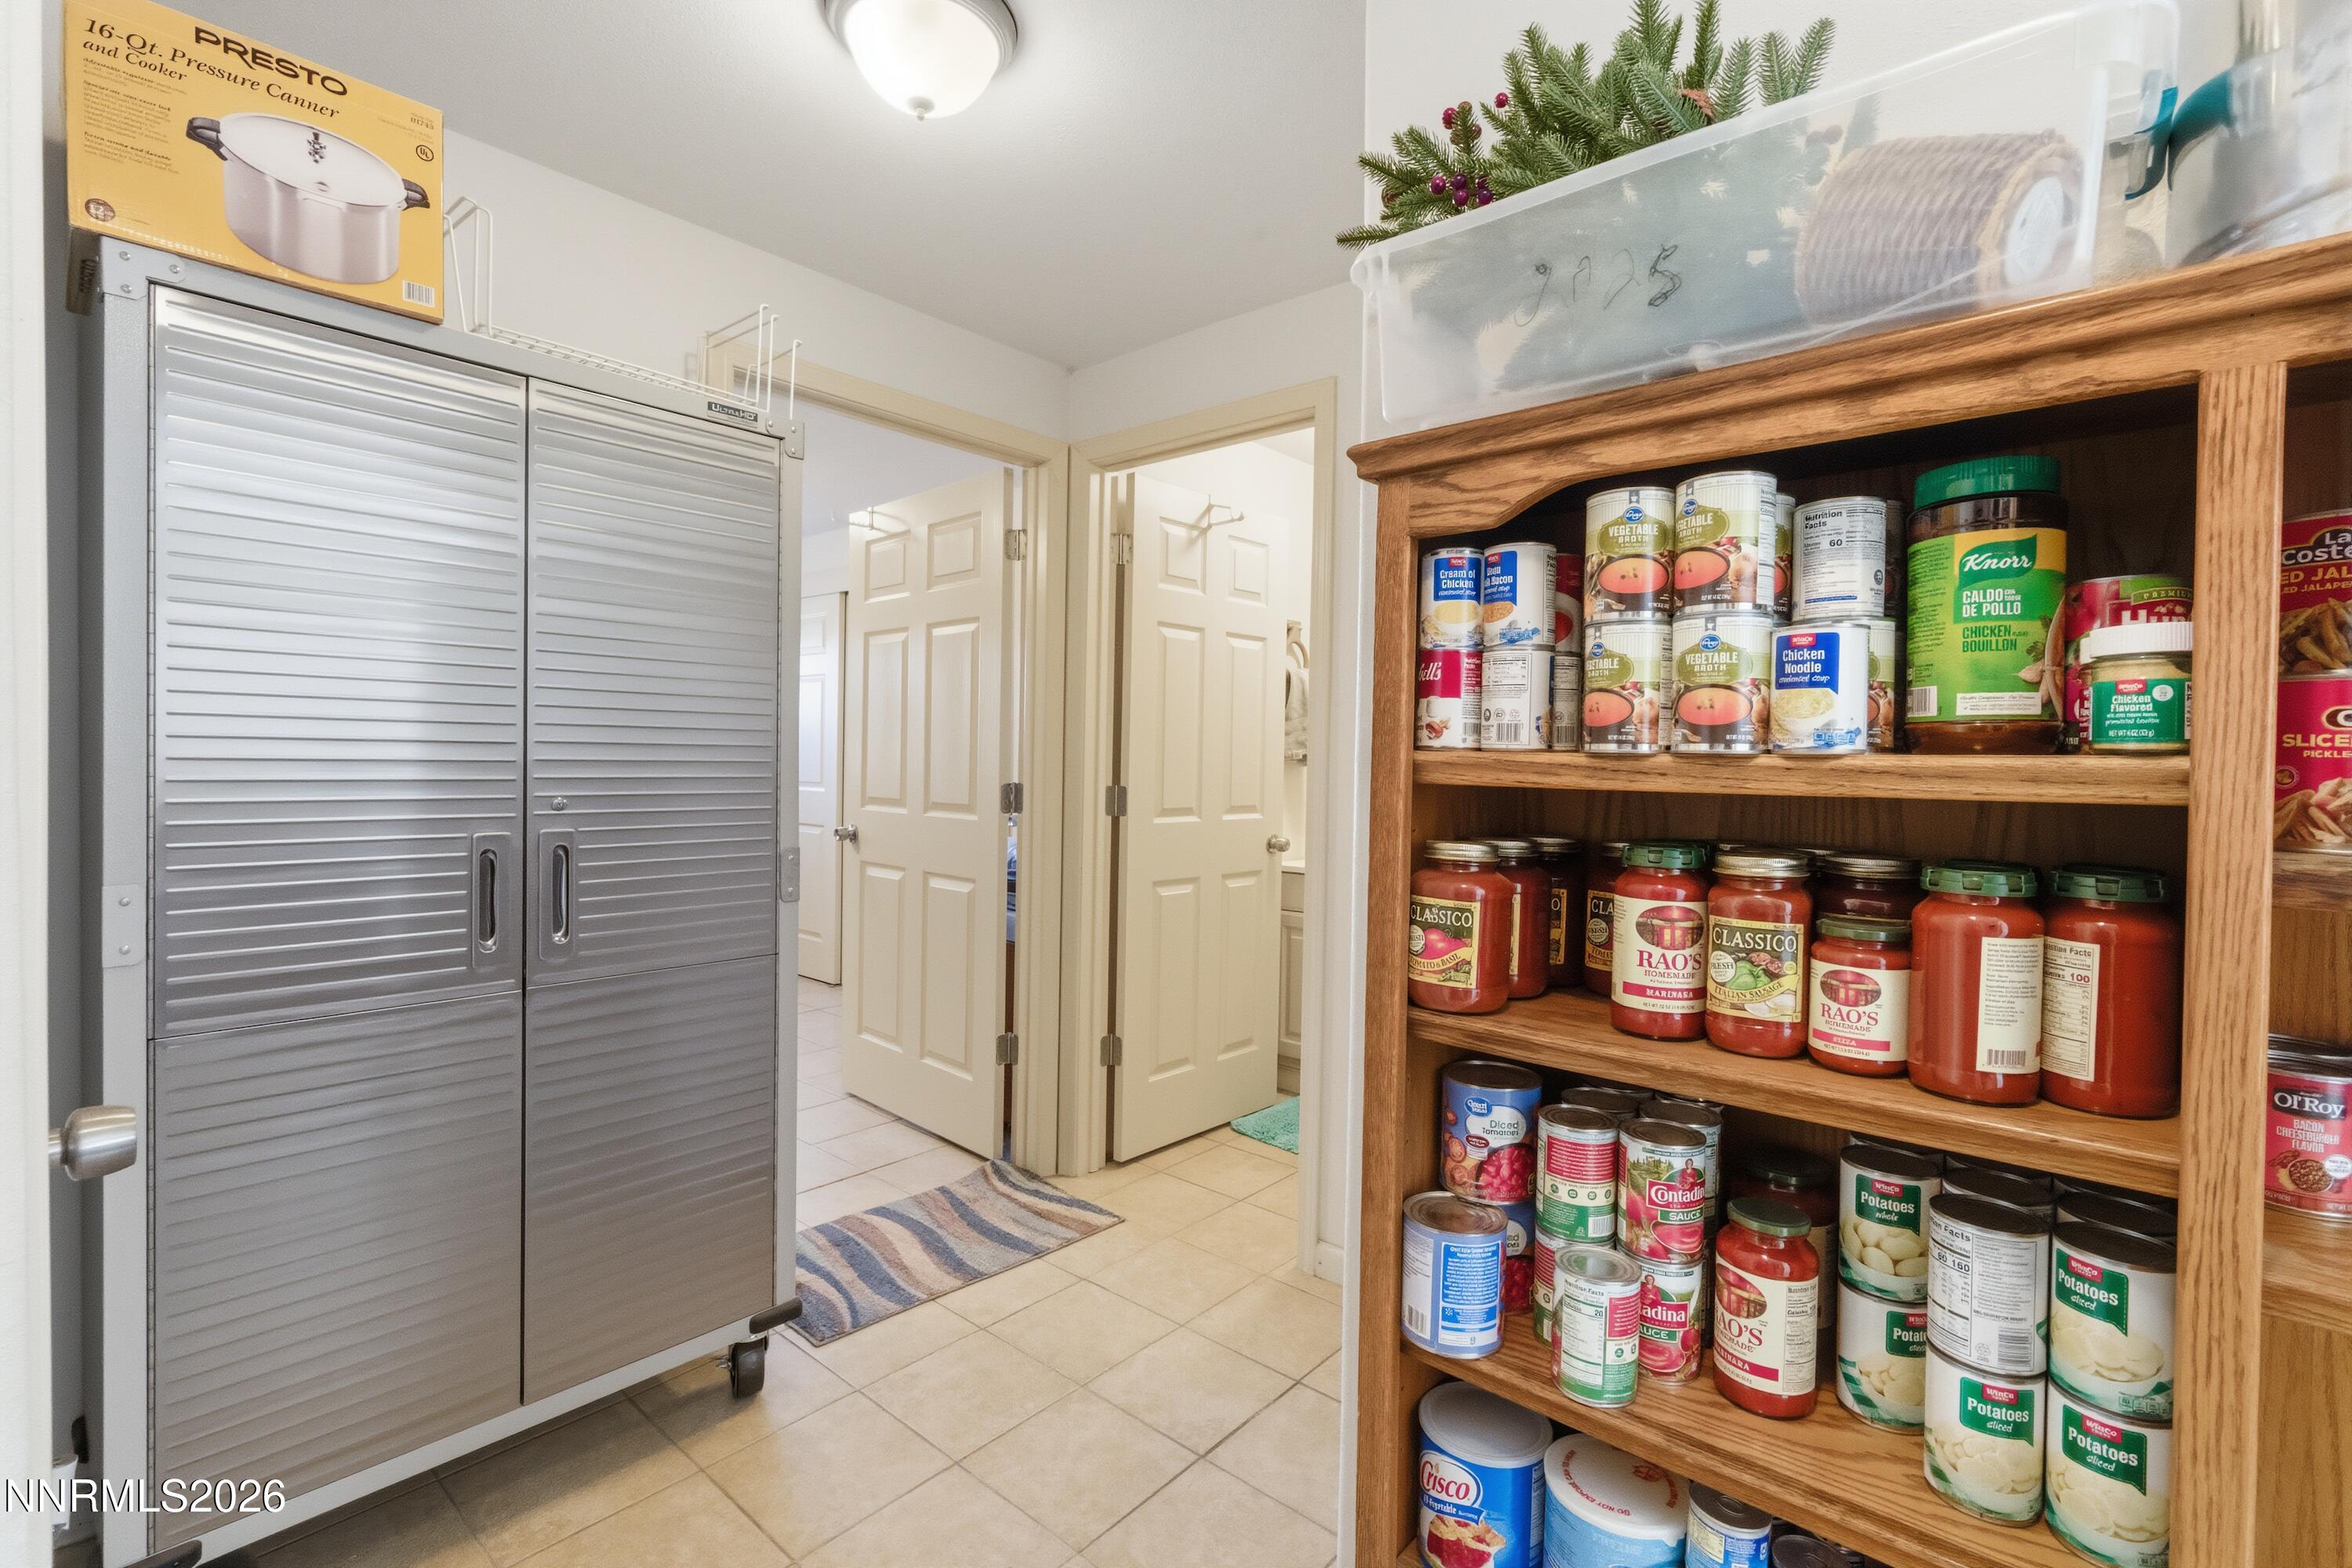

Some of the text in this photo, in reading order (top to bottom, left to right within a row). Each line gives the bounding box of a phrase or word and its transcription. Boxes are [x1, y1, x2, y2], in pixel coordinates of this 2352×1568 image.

[83, 41, 118, 58] and
[125, 53, 187, 80] Cooker
[195, 27, 347, 96] PRESTO
[83, 18, 163, 57] 16-Qt.
[169, 47, 260, 90] Pressure
[267, 83, 339, 118] Canner
[1805, 510, 1842, 522] Nutrition
[1609, 524, 1658, 537] VEGETABLE
[1805, 521, 1828, 529] Facts
[1829, 539, 1842, 547] 60
[2325, 532, 2352, 545] La
[1962, 553, 2032, 572] Knorr
[1440, 570, 1466, 579] Cream
[2311, 566, 2352, 580] JAL
[1442, 580, 1474, 589] Chicken
[2301, 581, 2352, 592] JALAPE
[1962, 589, 2003, 603] CALDO
[1962, 602, 2021, 617] DE POLLO
[1962, 625, 2011, 639] CHICKEN
[1962, 638, 2017, 652] BOUILLON
[1686, 652, 1738, 665] VEGETABLE
[1783, 648, 1825, 661] Chicken
[1418, 662, 1442, 681] bell's
[1785, 662, 1821, 673] Noodle
[2112, 695, 2151, 704] Chicken
[2111, 702, 2153, 712] Flavored
[2282, 734, 2352, 747] SLICE
[2303, 750, 2352, 758] PICKLE
[1713, 927, 1797, 953] CLASSICO
[2069, 947, 2092, 957] Facts
[1636, 949, 1702, 971] RAO'S
[1644, 970, 1697, 979] HOMEMADE
[2070, 973, 2090, 983] 100
[1715, 981, 1784, 999] ITALIAN SAUSAGE
[1820, 1004, 1878, 1026] RAO'S
[1490, 1120, 1519, 1129] Diced
[2293, 1119, 2325, 1133] BACON
[2276, 1126, 2339, 1145] CHEESEBURGER
[2292, 1140, 2324, 1152] FLAVOR
[1650, 1185, 1704, 1204] Contadin
[1860, 1192, 1915, 1213] Potatoes
[1669, 1209, 1701, 1221] SAUCE
[2058, 1269, 2119, 1305] Potatoes
[1642, 1305, 1686, 1323] adina
[1715, 1311, 1762, 1347] AO'S
[1968, 1397, 2029, 1422] Potatoes
[2068, 1426, 2138, 1466] Potatoes
[1421, 1461, 1471, 1501] Crisco
